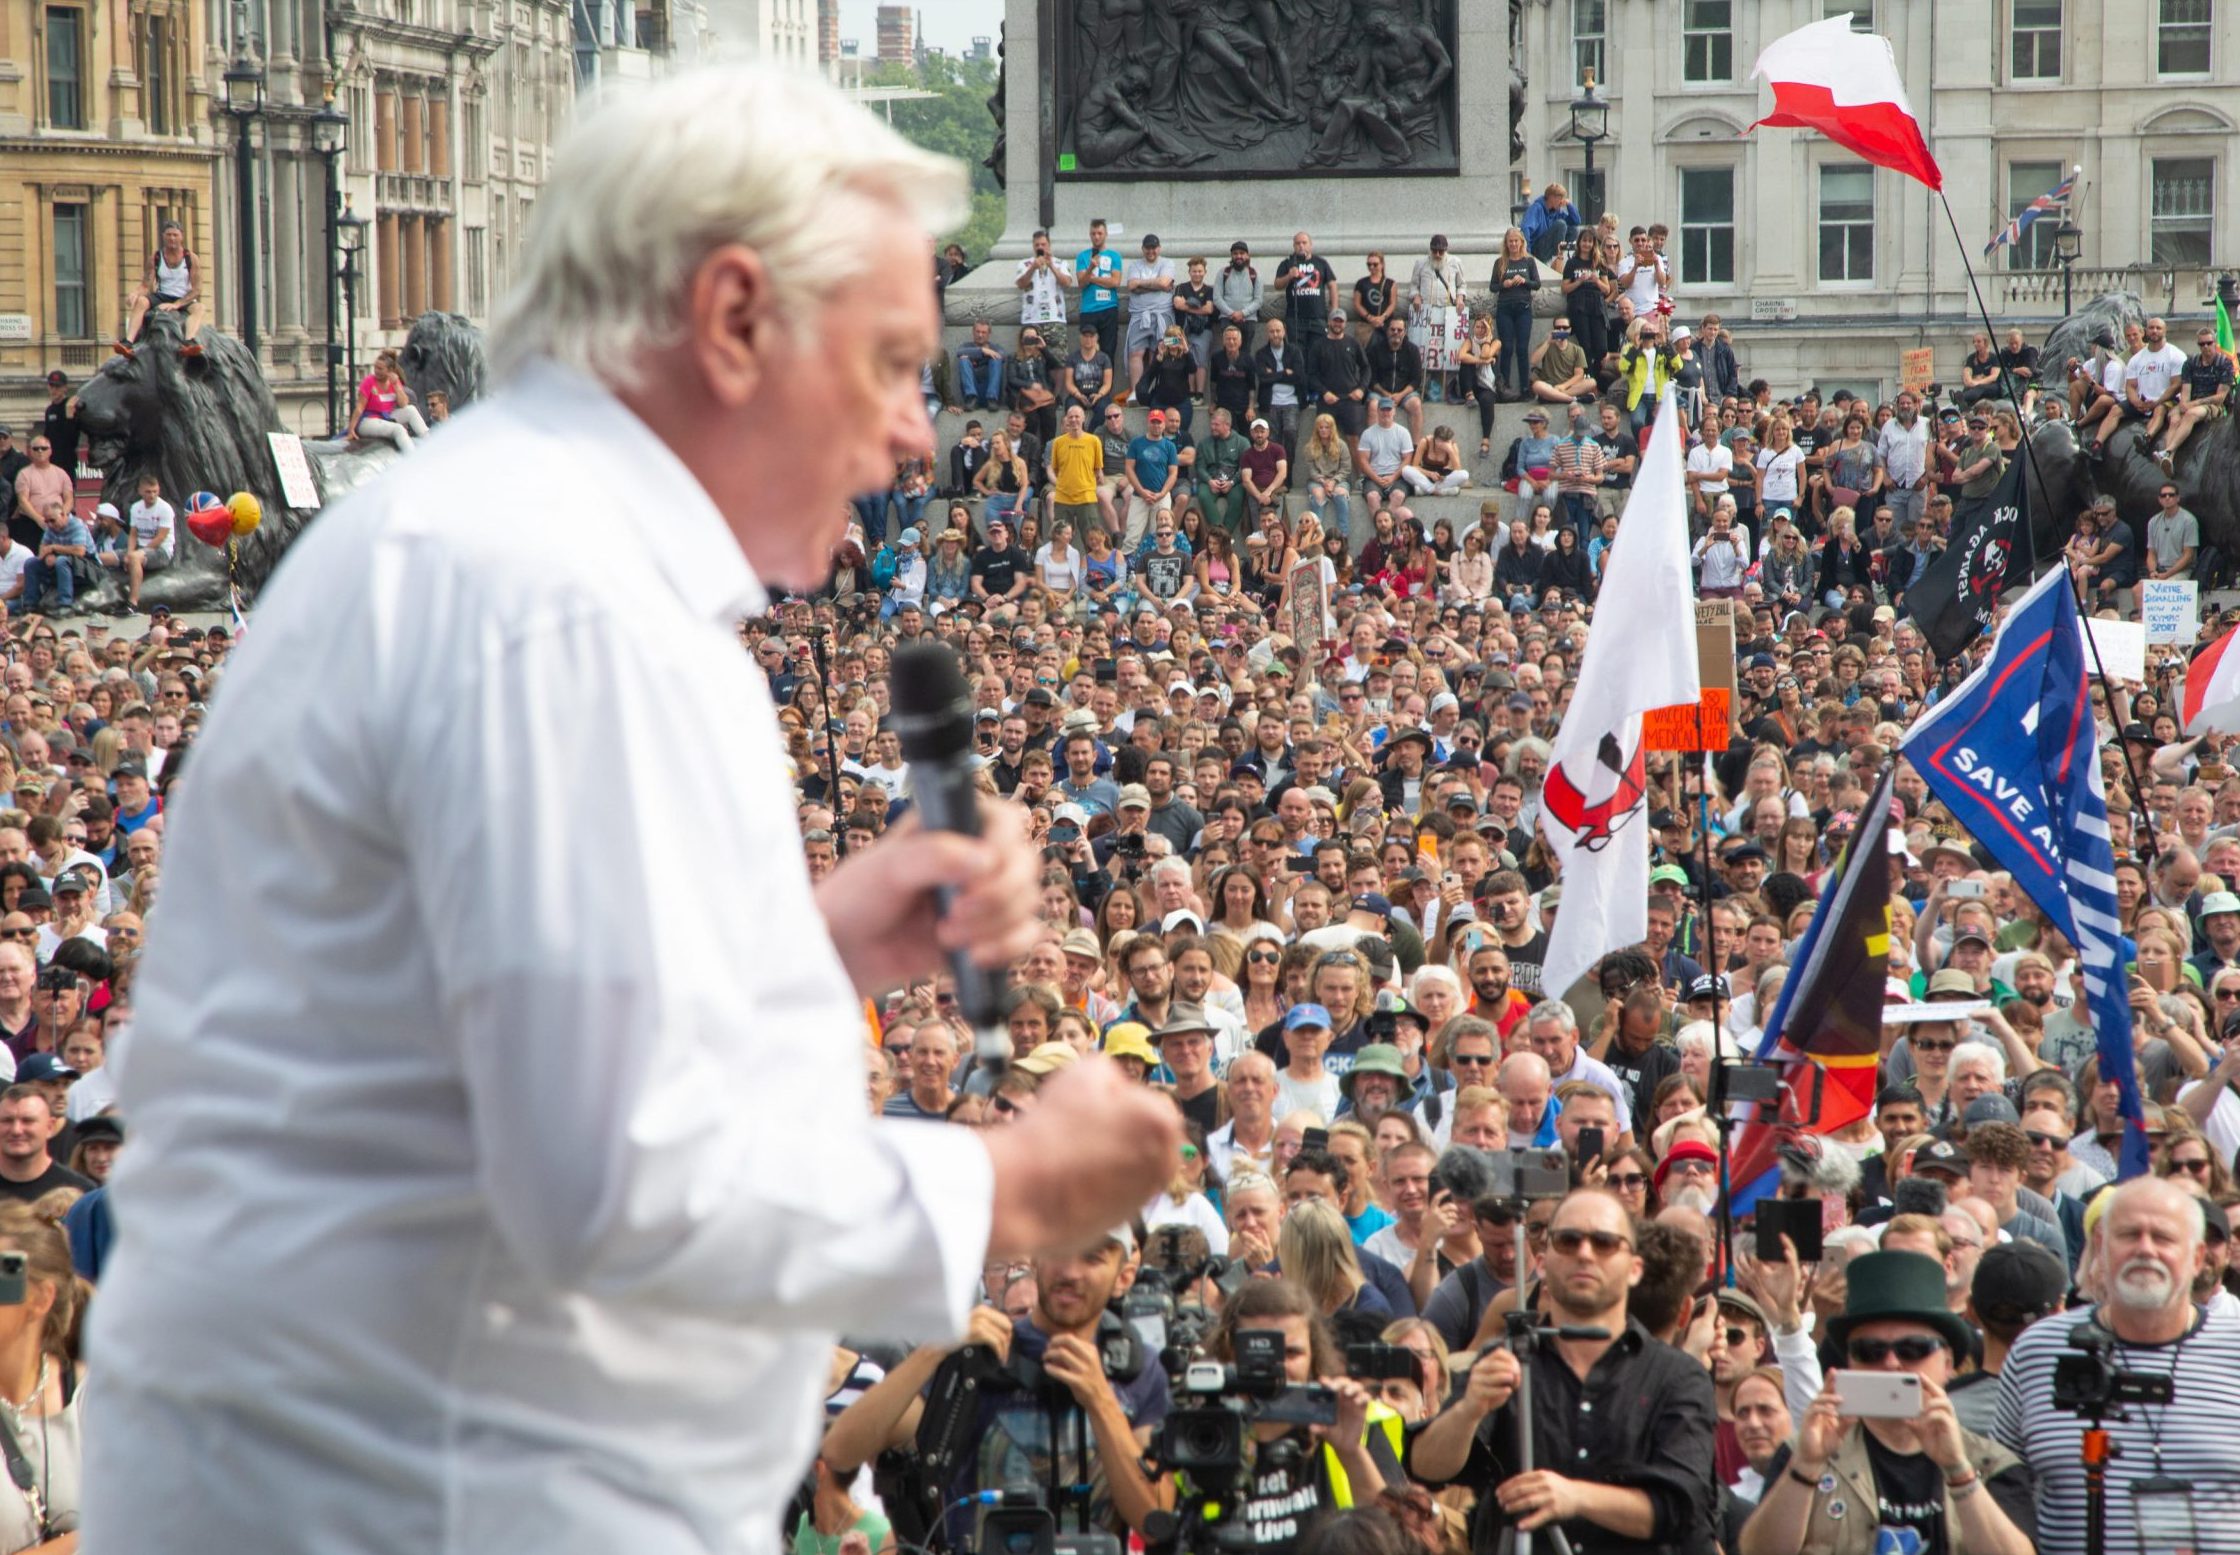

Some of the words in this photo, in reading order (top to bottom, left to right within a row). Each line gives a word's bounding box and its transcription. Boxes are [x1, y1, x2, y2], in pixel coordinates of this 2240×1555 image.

[1299, 263, 1314, 273] NO
[2151, 623, 2177, 632] SPORT
[1654, 704, 1728, 724] VACCINTION
[1645, 727, 1695, 750] MEDICAL
[1953, 747, 2034, 822] SAVE
[1627, 1068, 1641, 1082] NO
[1258, 1468, 1288, 1495] Let
[1247, 1484, 1318, 1521] rnwall
[1254, 1517, 1297, 1544] Live
